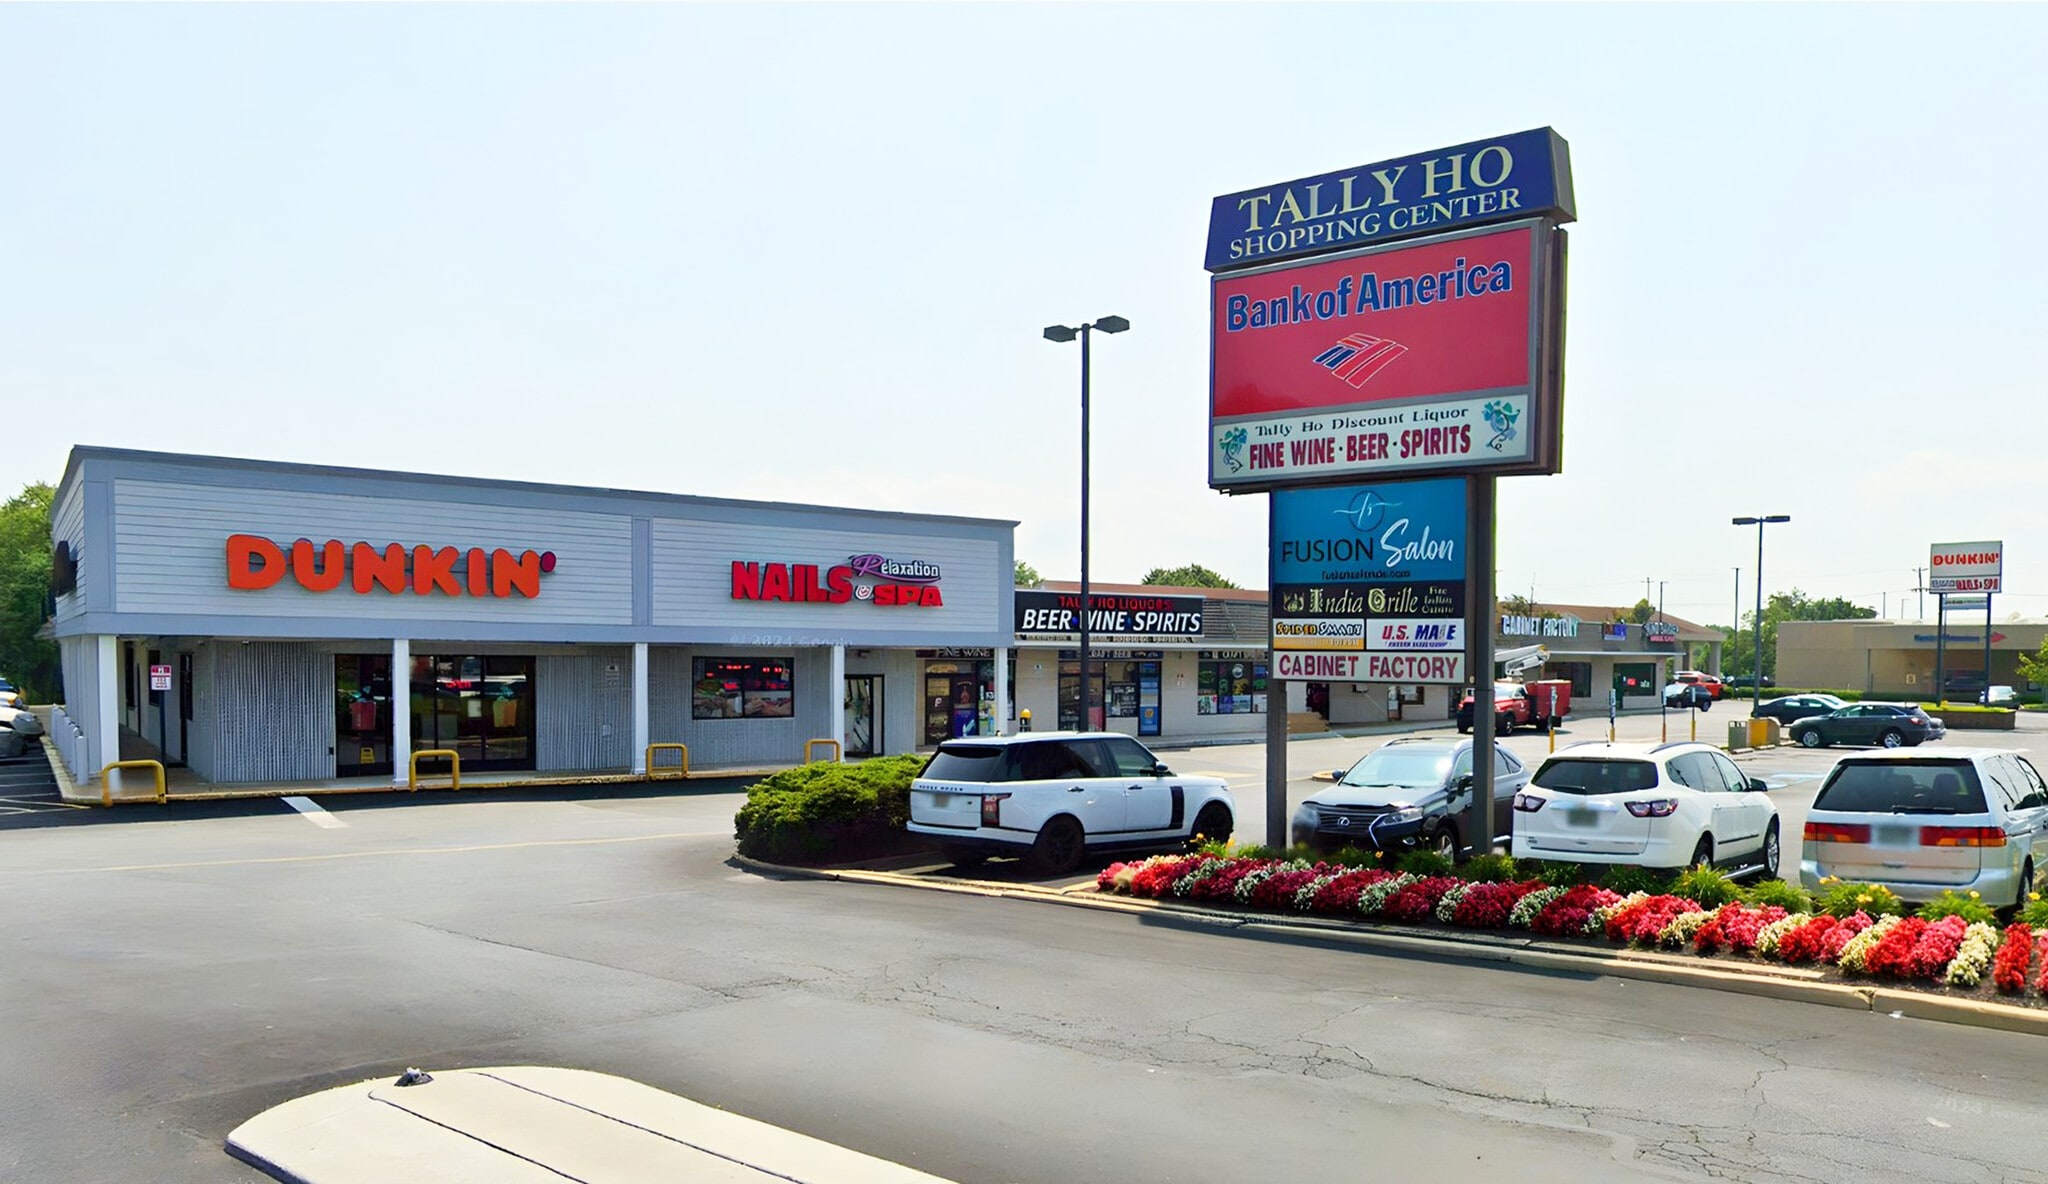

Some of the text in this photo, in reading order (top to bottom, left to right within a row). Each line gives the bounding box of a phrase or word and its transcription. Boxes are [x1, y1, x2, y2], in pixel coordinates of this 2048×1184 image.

[1238, 145, 1514, 232] TALLY HO
[1229, 188, 1522, 259] SHOPPING CENTER
[1226, 257, 1513, 332] Bank of America
[1255, 407, 1469, 438] Tally Ho Discount Liquor
[1249, 424, 1472, 470] FINE WINE BEER SPIRITS
[225, 533, 556, 599] DUNKIN'
[1282, 518, 1454, 568] FUSION Salon
[1932, 552, 1999, 566] DUNKIN'
[731, 560, 943, 607] NAILS SPA
[848, 553, 942, 584] Relaxation
[1022, 608, 1072, 630] BEER
[1132, 612, 1201, 632] SPIRITS
[1309, 586, 1418, 614] India Grille
[1279, 654, 1459, 679] CABINET FACTORY
